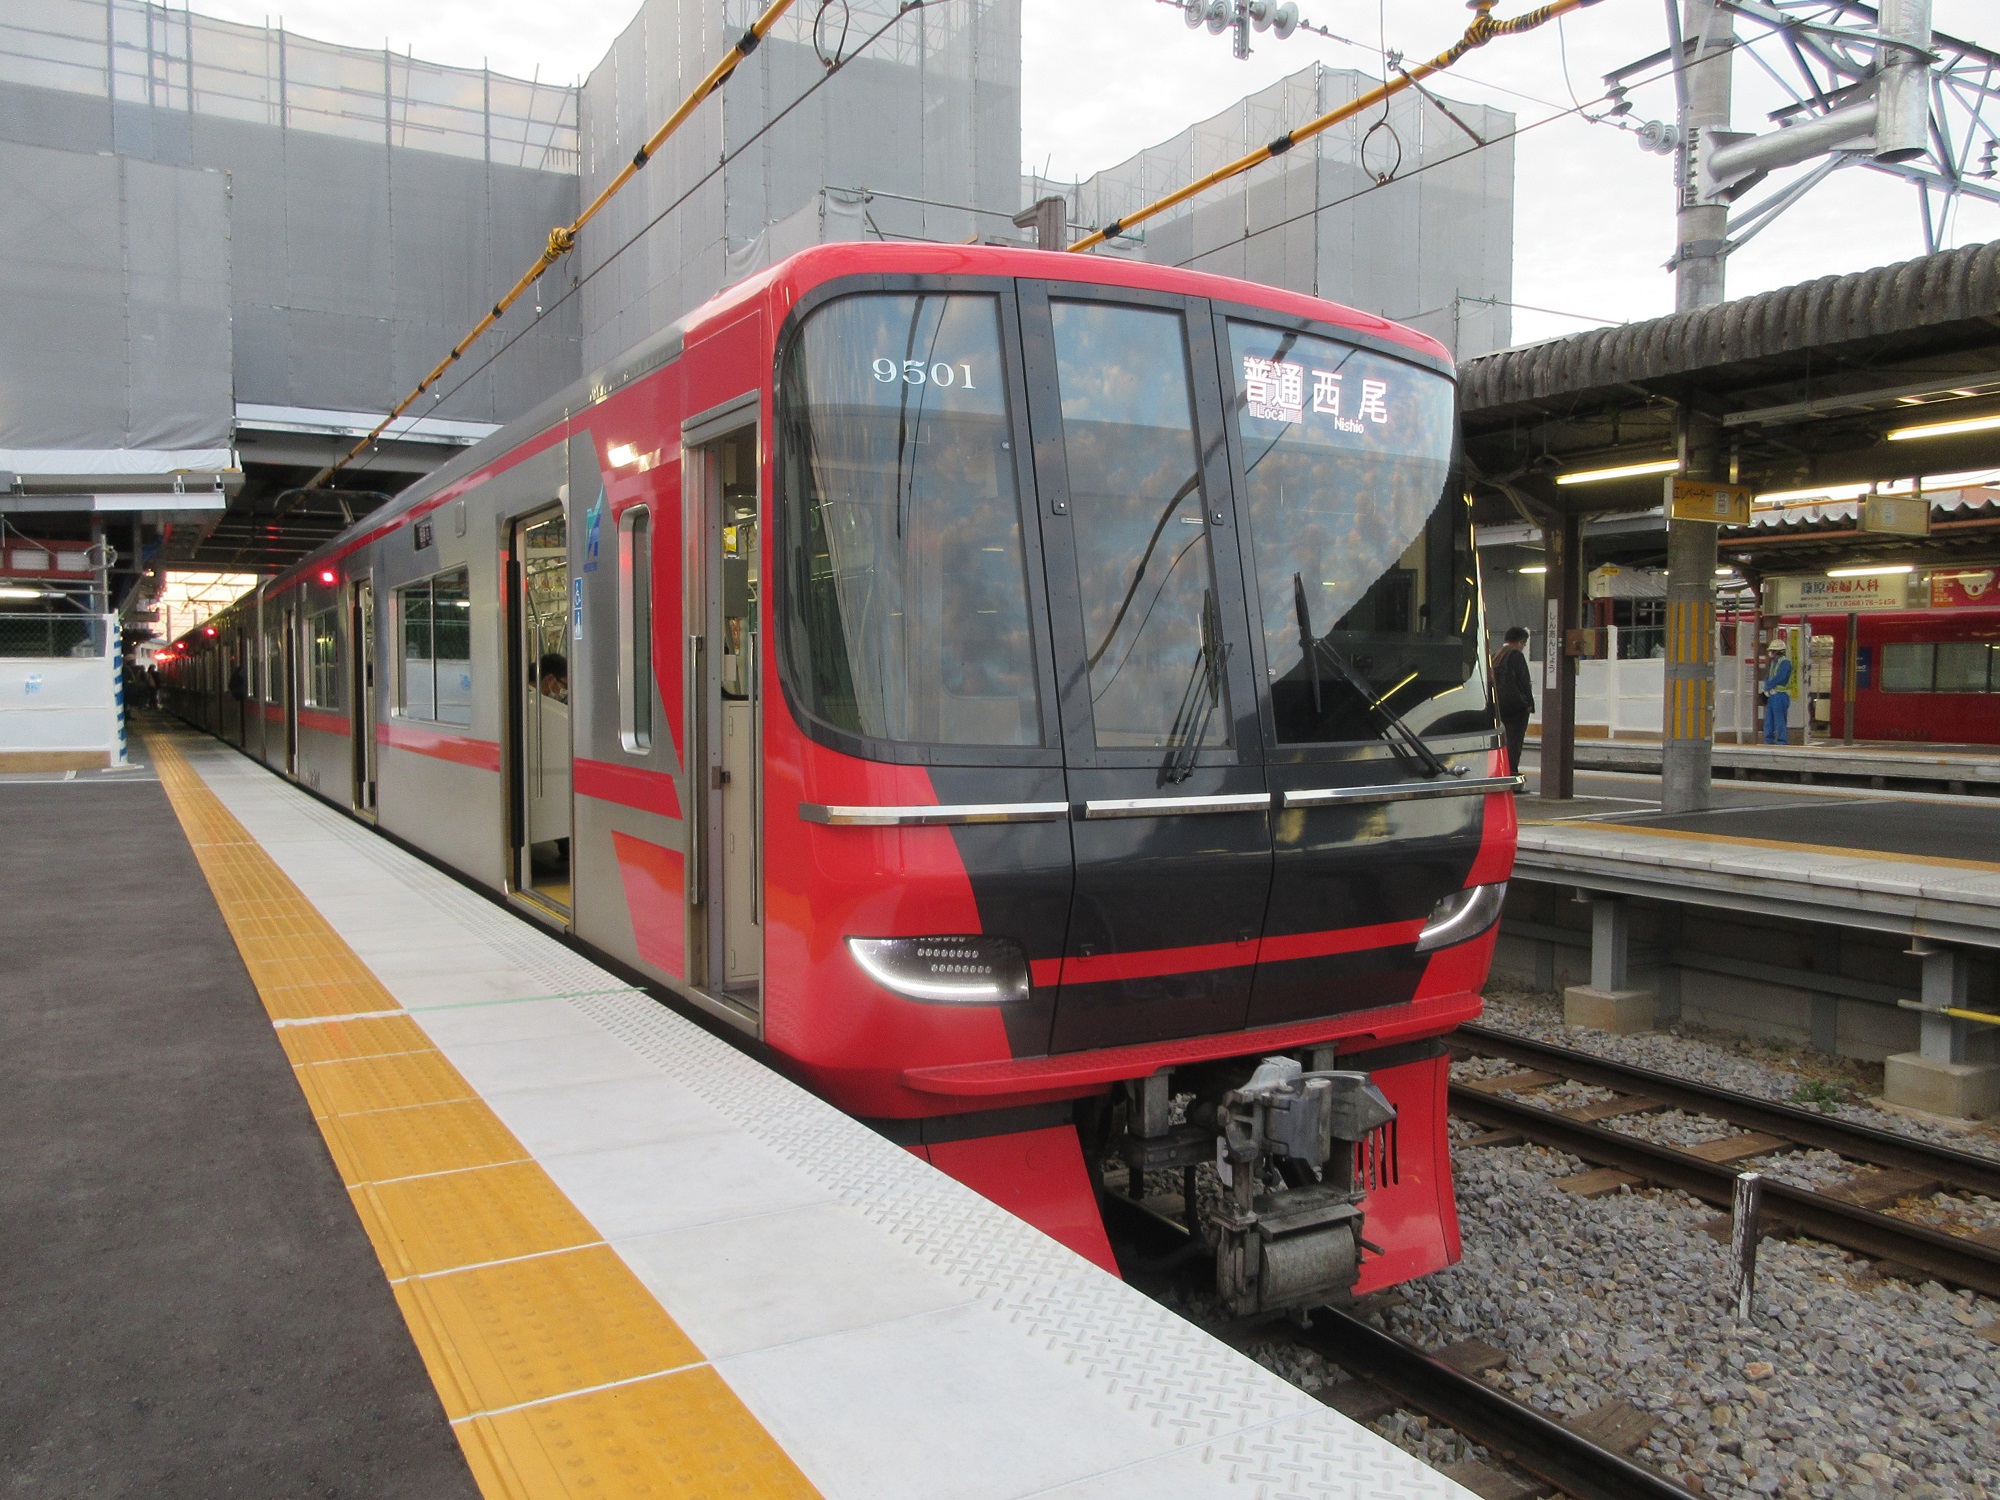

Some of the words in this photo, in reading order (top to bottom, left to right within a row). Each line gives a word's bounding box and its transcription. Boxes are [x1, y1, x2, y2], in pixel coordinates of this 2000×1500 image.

[872, 358, 977, 390] 9501
[1243, 356, 1303, 411] 普通
[1311, 369, 1388, 424] 西尾
[1256, 403, 1287, 423] Local
[1333, 416, 1365, 435] Nishio
[1547, 611, 1557, 674] しんあんじょう
